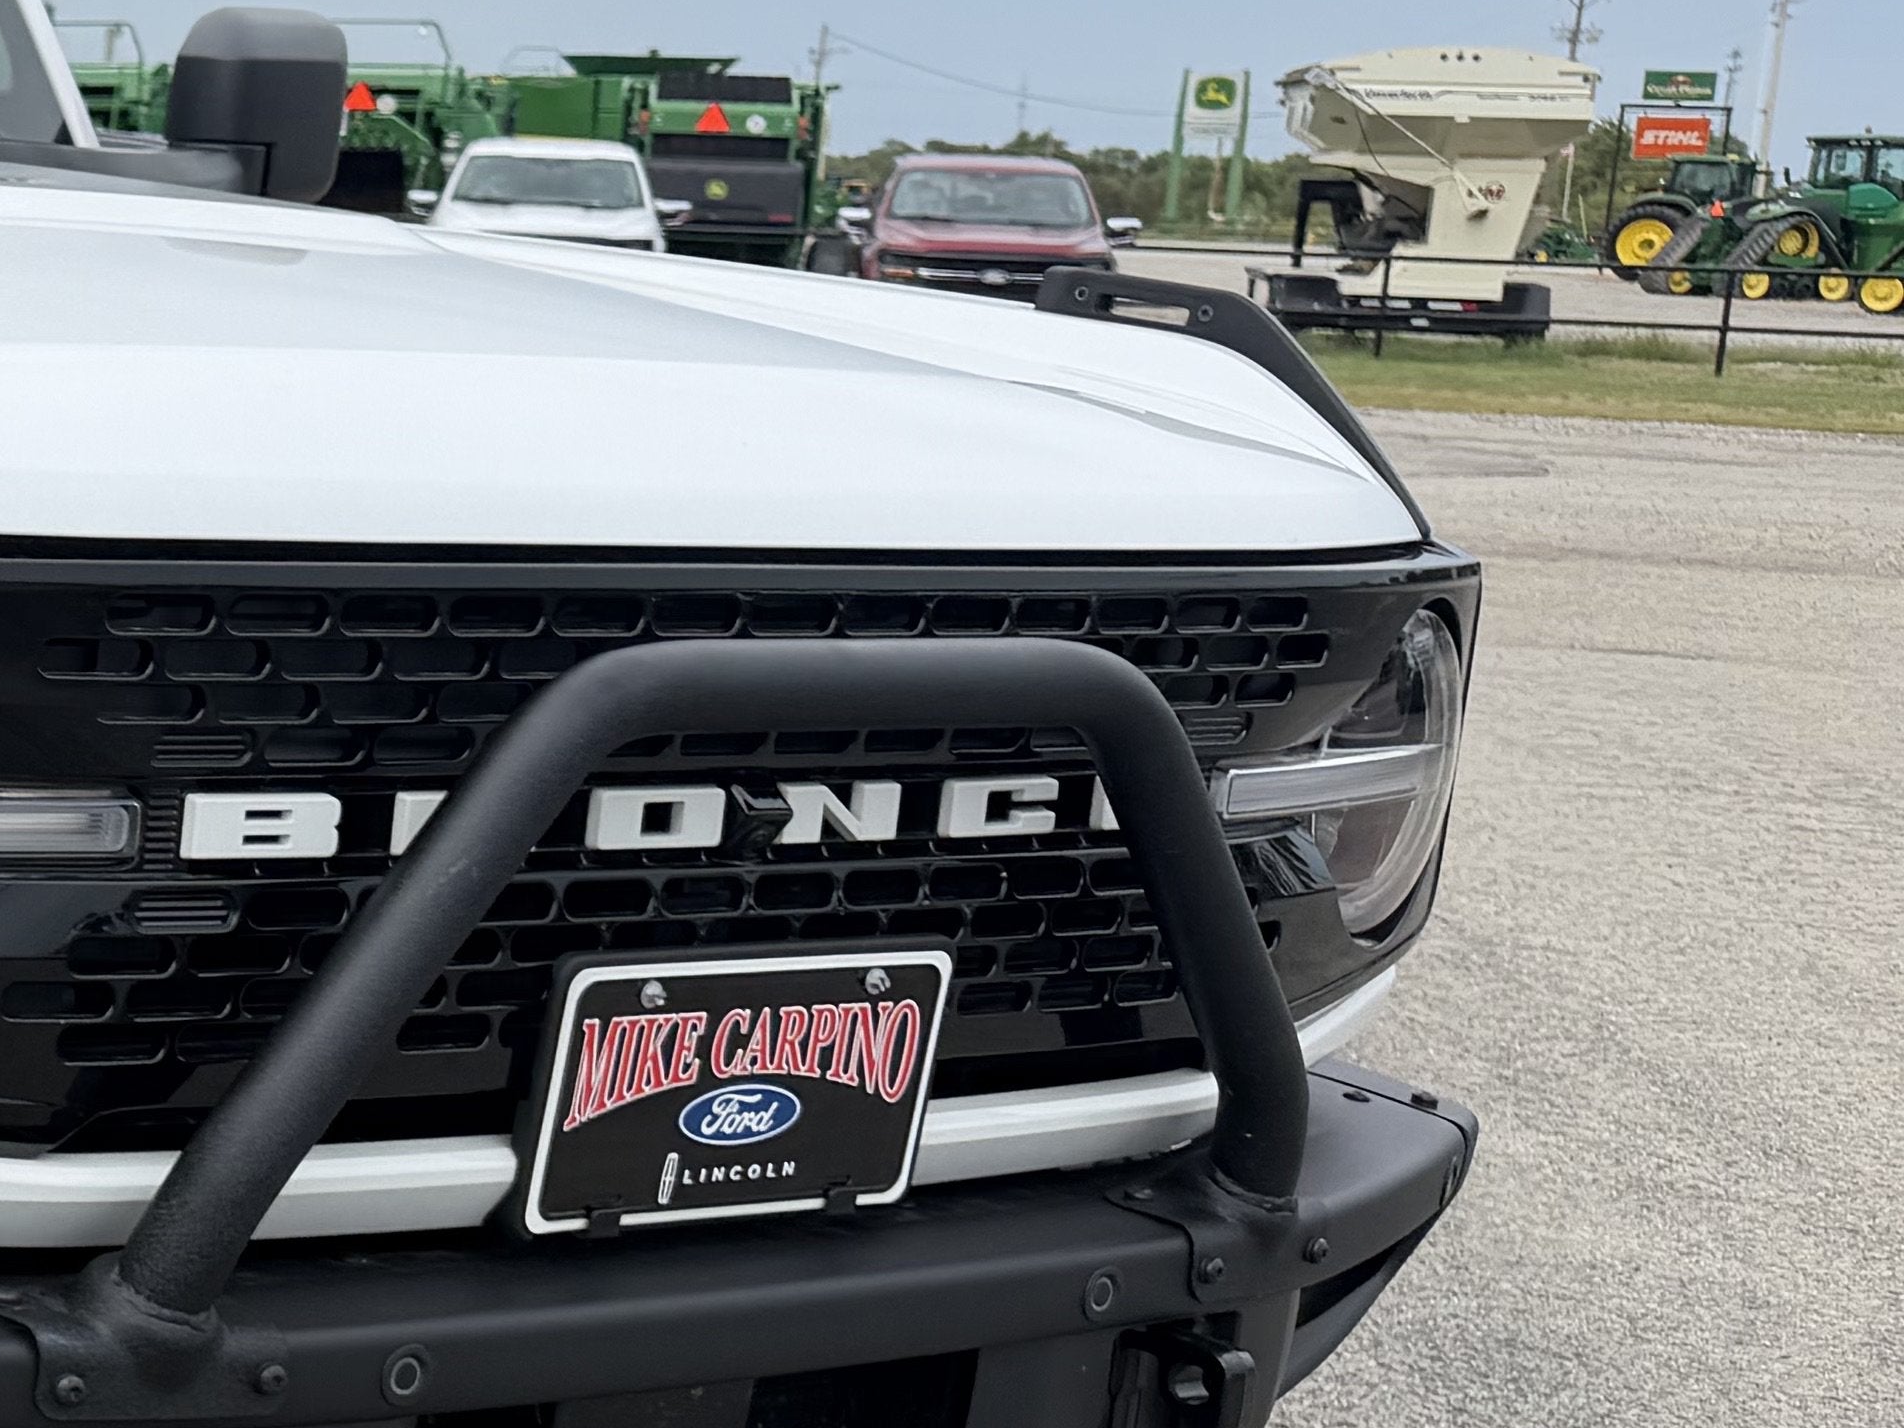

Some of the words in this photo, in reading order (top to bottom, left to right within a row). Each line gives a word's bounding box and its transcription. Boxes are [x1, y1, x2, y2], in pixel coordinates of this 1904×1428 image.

[1639, 129, 1704, 146] STIHL
[180, 775, 1121, 860] BONC
[562, 1010, 708, 1132] MIKE
[710, 999, 921, 1103] CARPINO
[700, 1093, 775, 1135] Ford
[682, 1160, 797, 1186] LINCOLN
